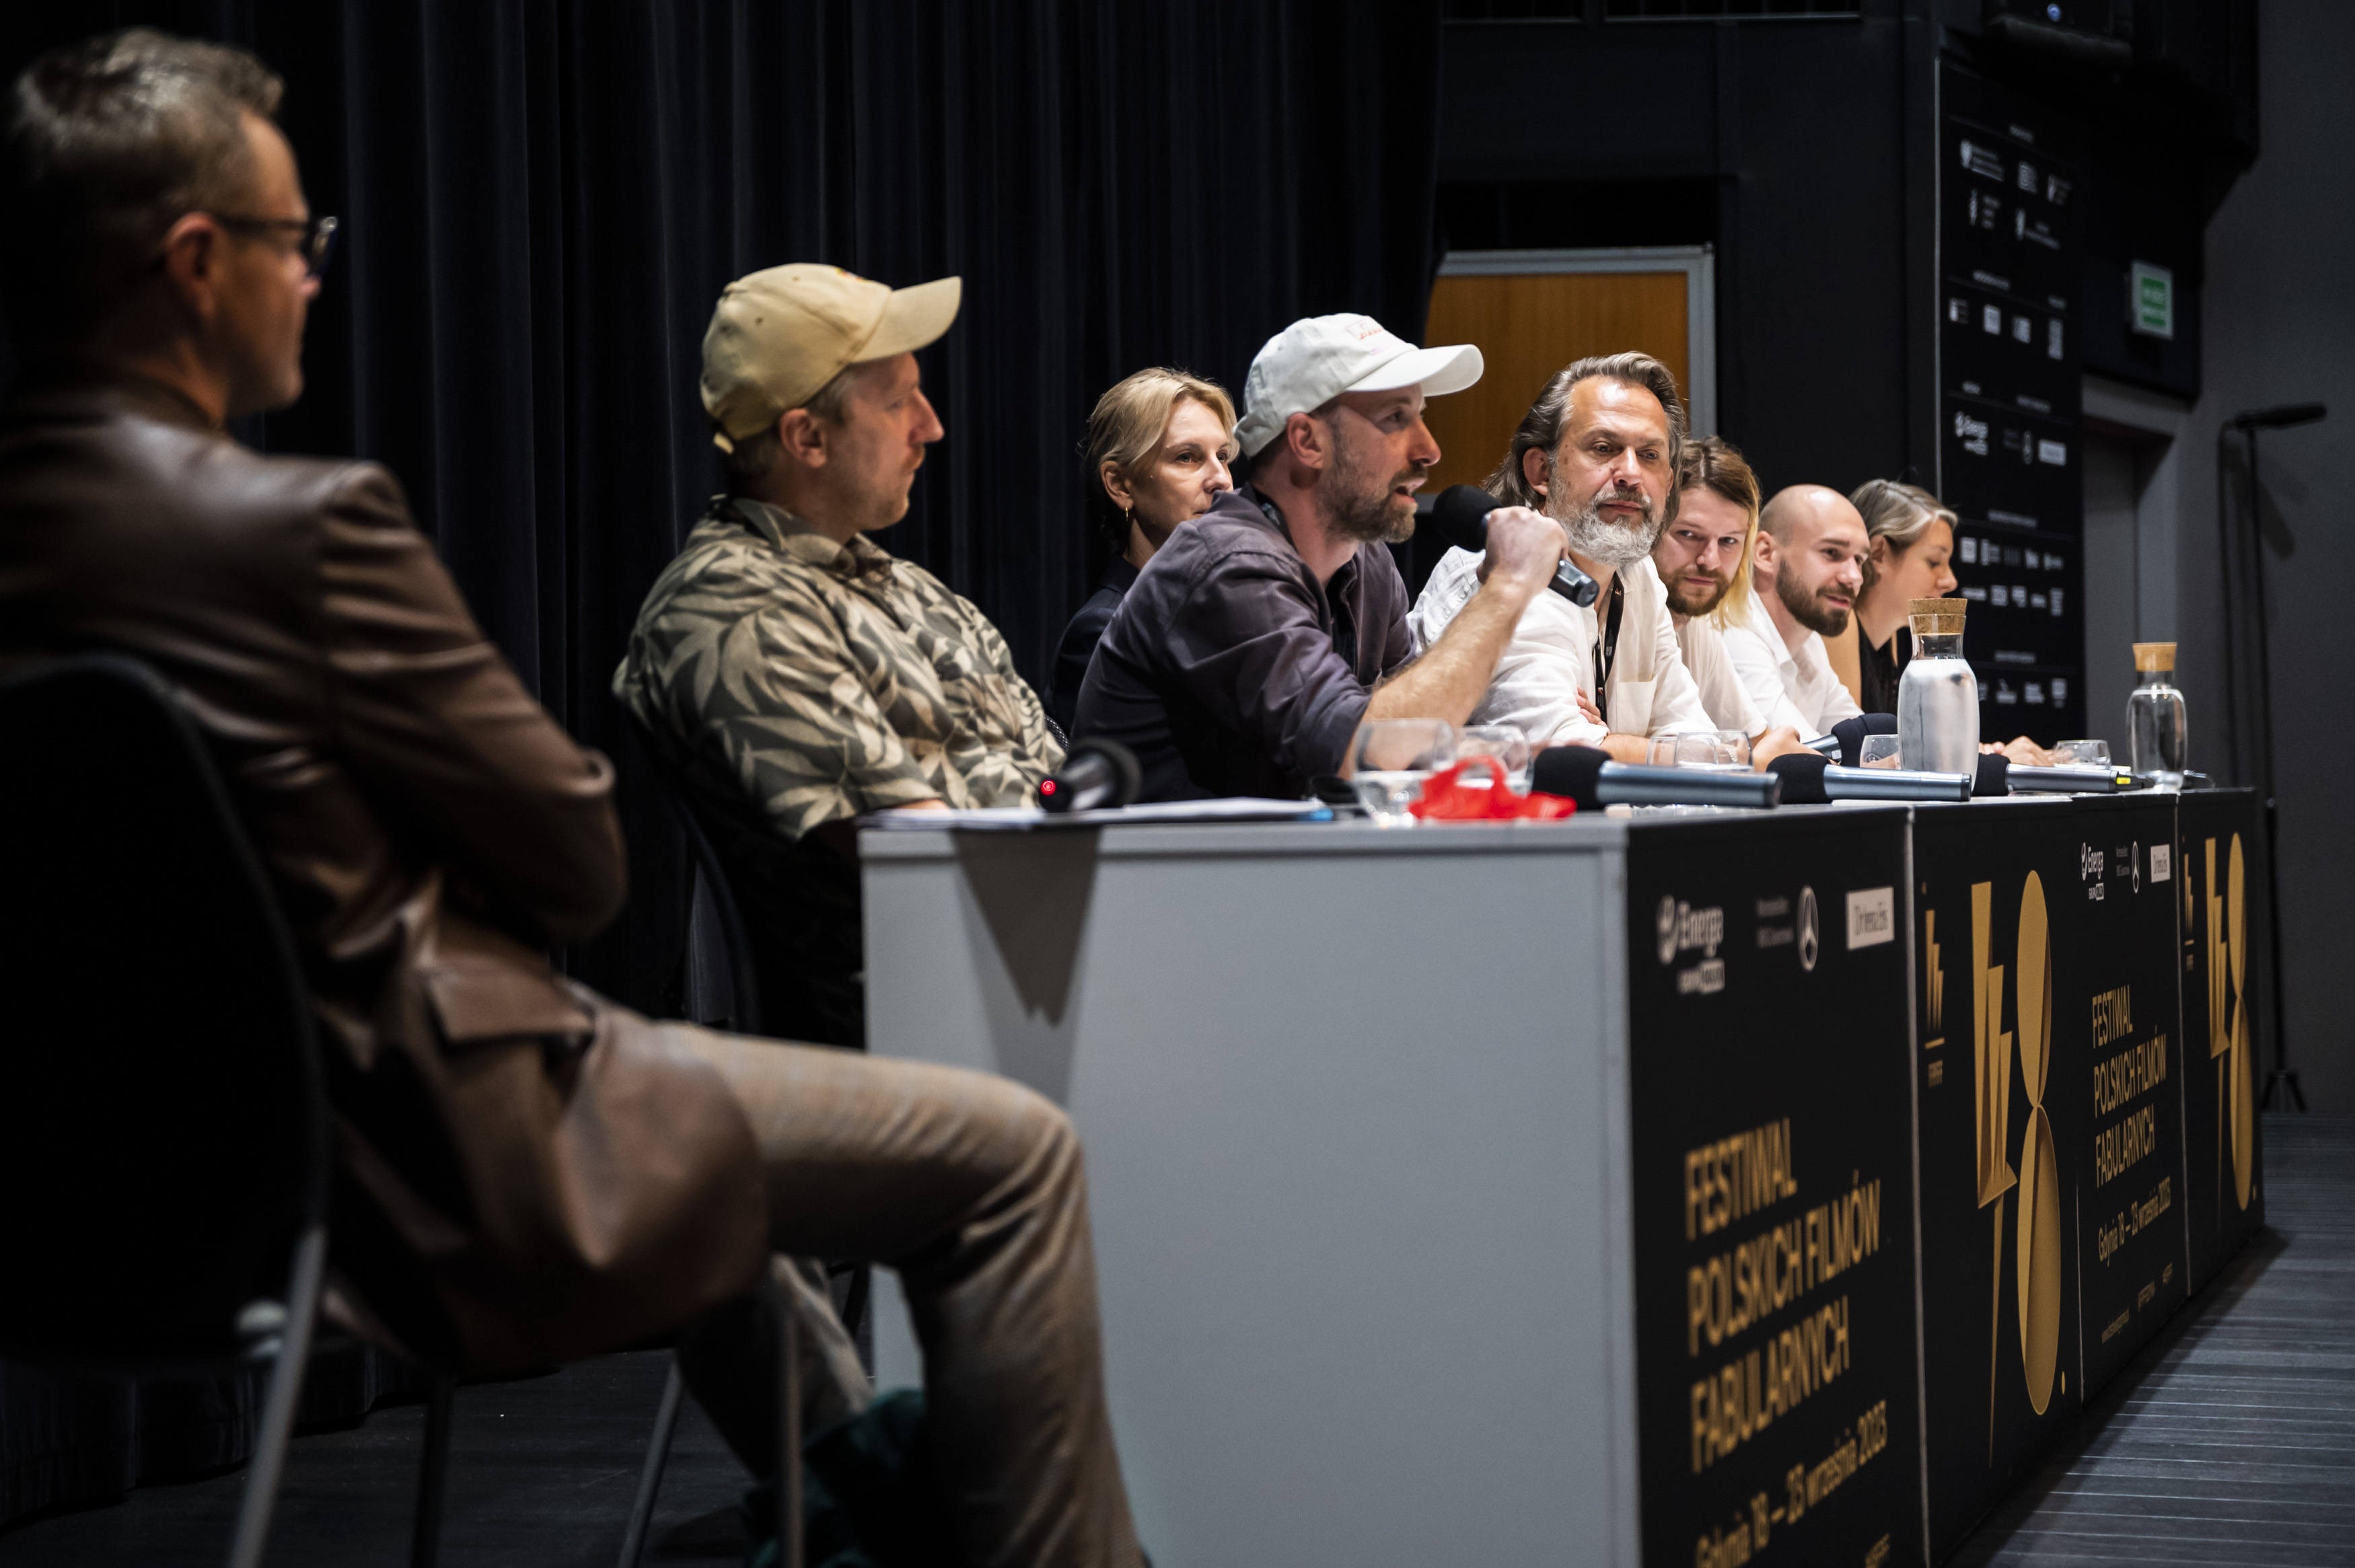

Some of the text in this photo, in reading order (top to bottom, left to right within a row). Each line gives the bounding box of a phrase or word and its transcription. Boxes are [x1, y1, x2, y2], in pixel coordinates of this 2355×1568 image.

[2087, 846, 2103, 880] Energa
[2093, 984, 2133, 1049] FESTIWAL
[2094, 1024, 2167, 1118] POLSKICH FILMÓW
[1686, 1117, 1797, 1241] FESTIWAL
[2096, 1103, 2154, 1188] FABULARNYCH
[1688, 1169, 1881, 1357] POLSKICH FILMÓW
[2099, 1218, 2118, 1267] Gdynia
[1692, 1295, 1850, 1474] FABULARNYCH
